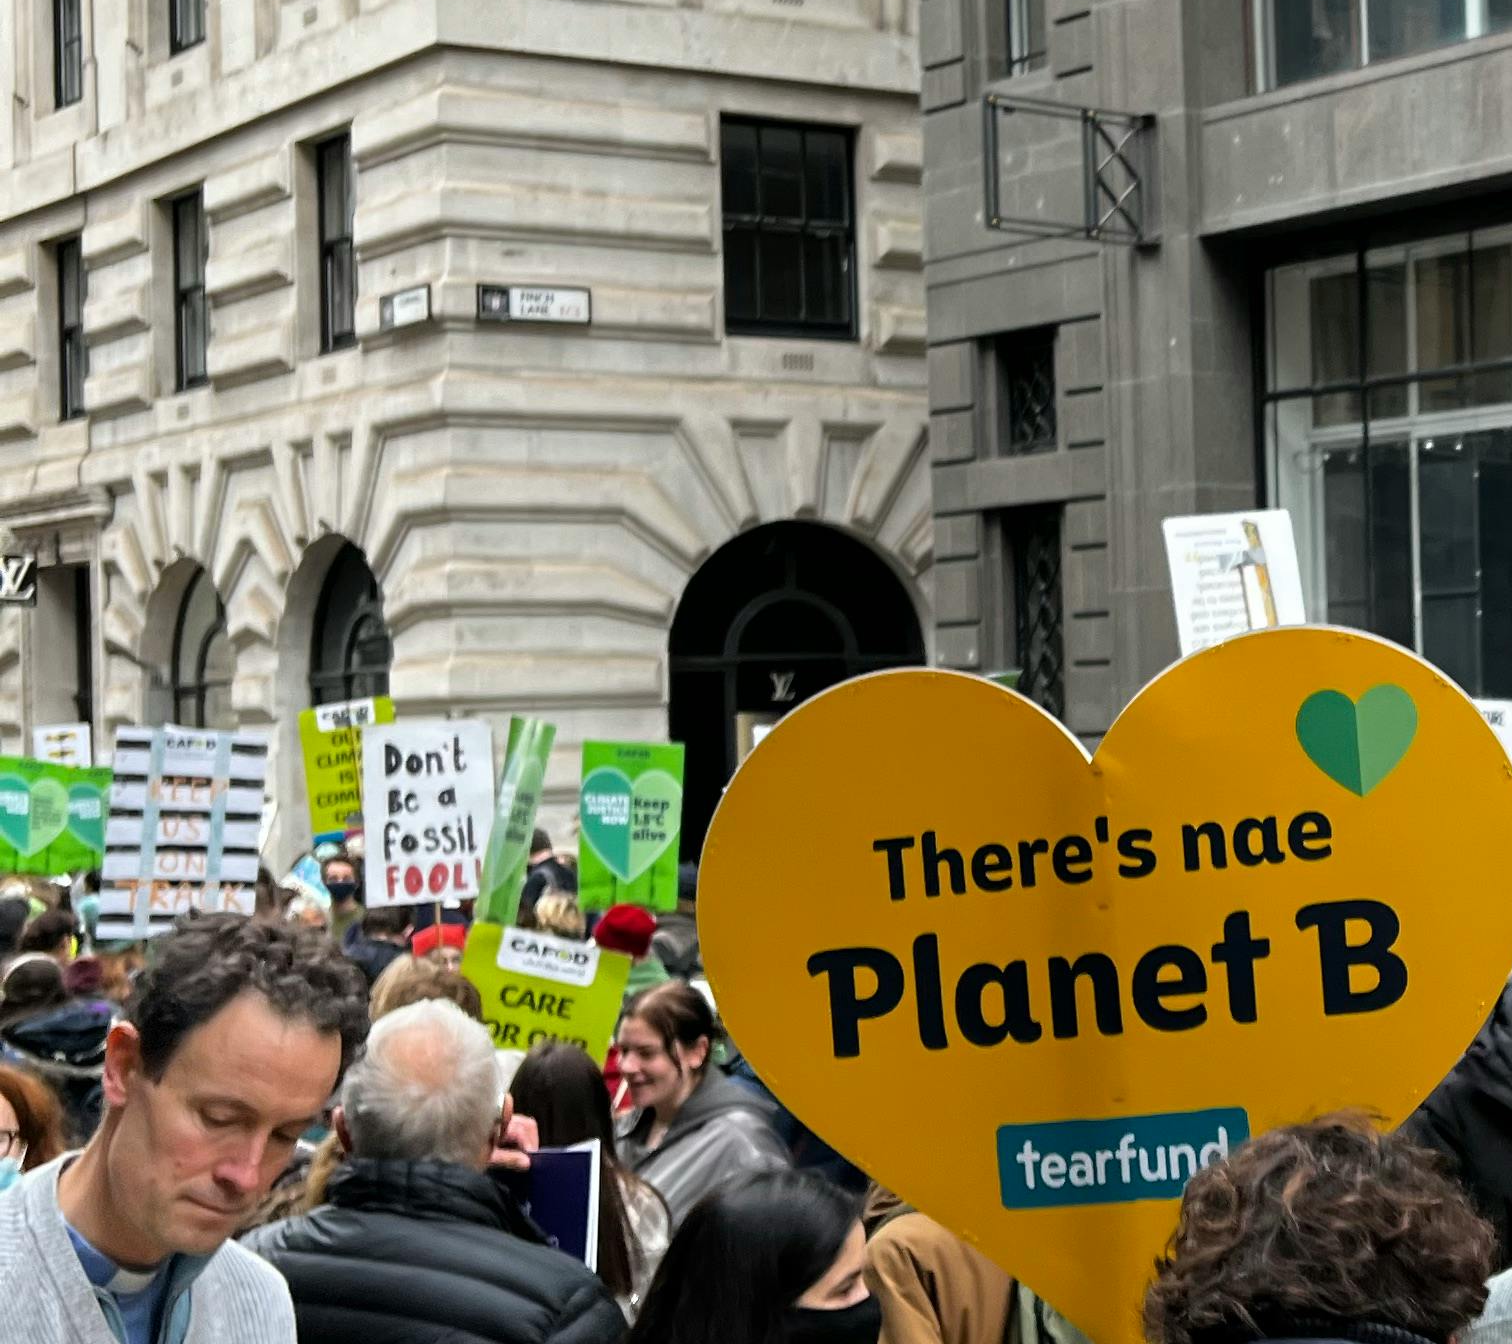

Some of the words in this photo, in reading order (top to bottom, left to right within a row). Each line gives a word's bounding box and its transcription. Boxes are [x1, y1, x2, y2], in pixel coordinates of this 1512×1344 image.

[384, 735, 468, 777] Don't
[437, 787, 457, 806] a
[583, 793, 630, 806] CLIMATE
[633, 797, 670, 812] Keep
[586, 805, 629, 816] JUSTICE
[601, 814, 628, 826] NOW
[162, 813, 201, 838] US
[631, 828, 667, 842] alive
[159, 852, 205, 873] ON
[872, 815, 1157, 902] There's
[1181, 810, 1333, 872] nae
[114, 879, 245, 911] TRACK
[806, 909, 1271, 1058] Planet
[1294, 899, 1409, 1016] B
[500, 984, 575, 1020] CARE
[490, 1018, 521, 1047] OR
[1015, 1125, 1231, 1192] tearfund
